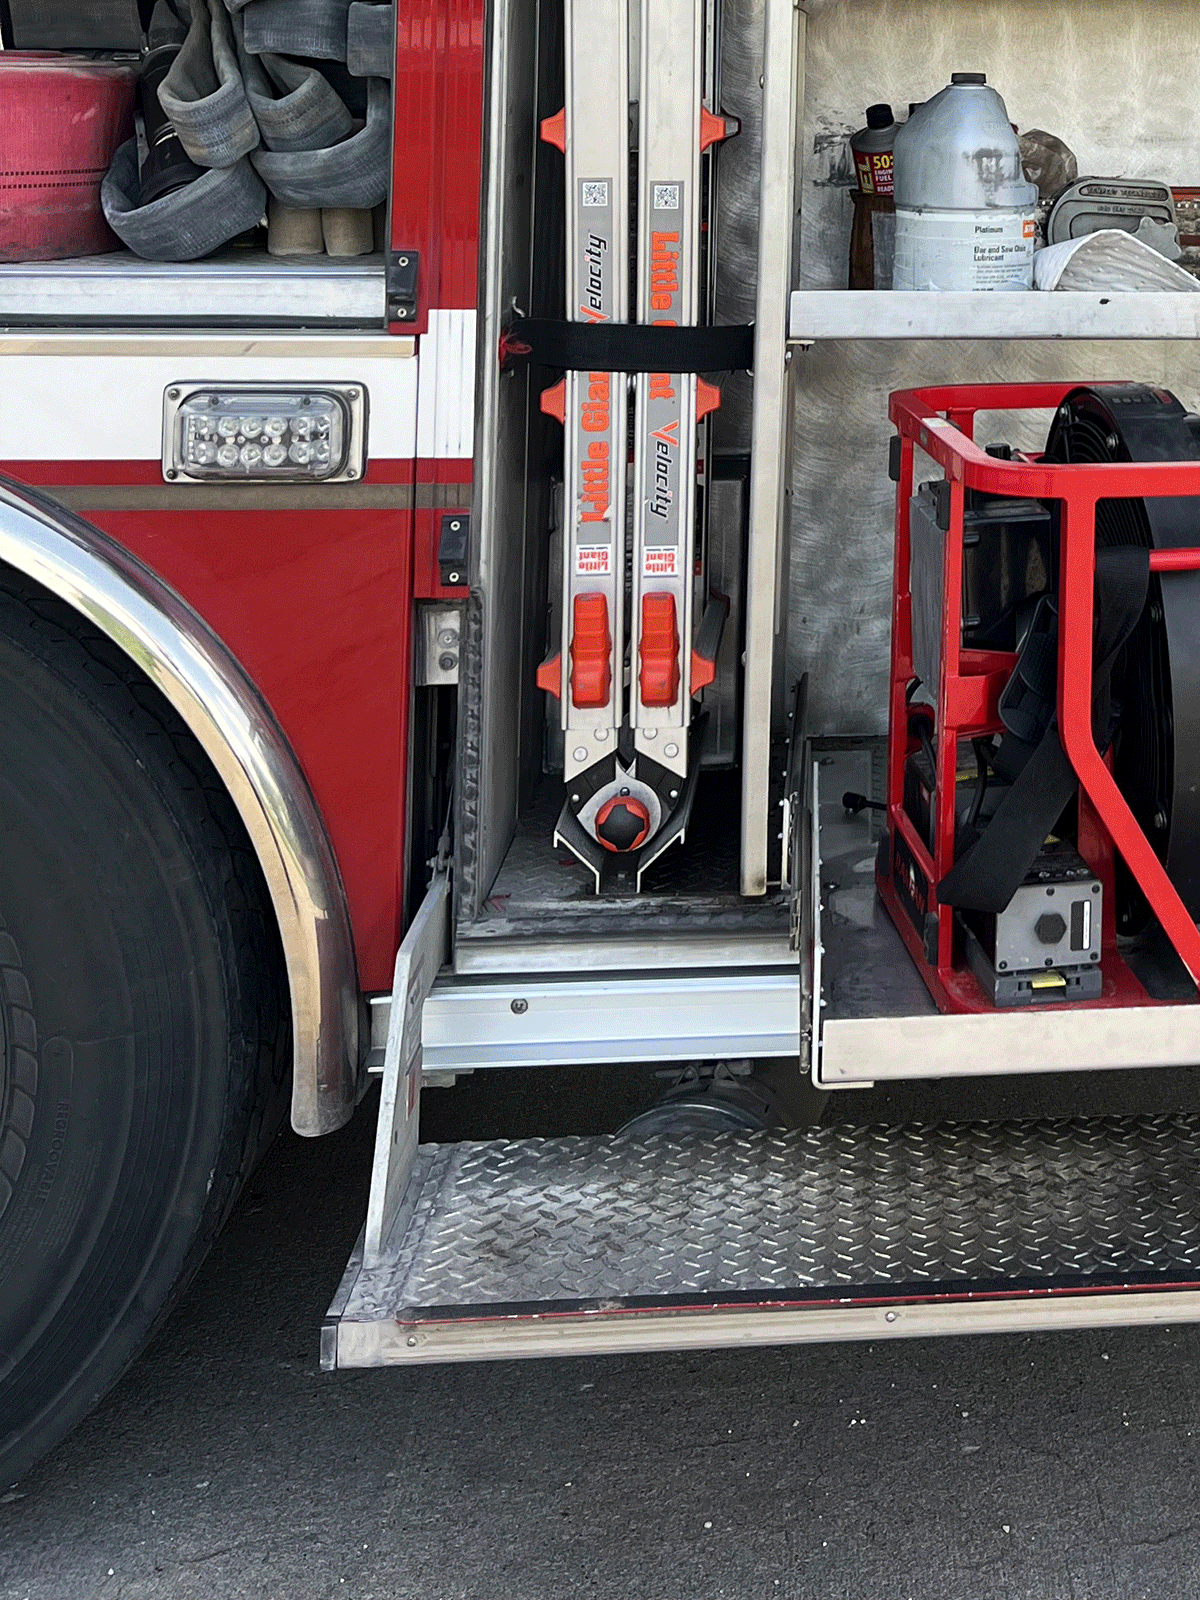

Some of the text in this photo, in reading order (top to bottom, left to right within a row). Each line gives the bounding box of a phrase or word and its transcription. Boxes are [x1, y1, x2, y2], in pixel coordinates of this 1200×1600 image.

[975, 225, 1003, 234] Platinum
[974, 246, 987, 254] Bar
[988, 246, 1000, 254] and
[1001, 245, 1013, 253] Saw
[974, 254, 1004, 262] Lubricant
[650, 231, 679, 310] Little
[648, 419, 680, 518] Velocity
[580, 441, 610, 522] Little
[579, 551, 609, 561] Giant
[645, 553, 675, 563] Giant
[579, 561, 609, 571] Little
[645, 563, 675, 572] Little
